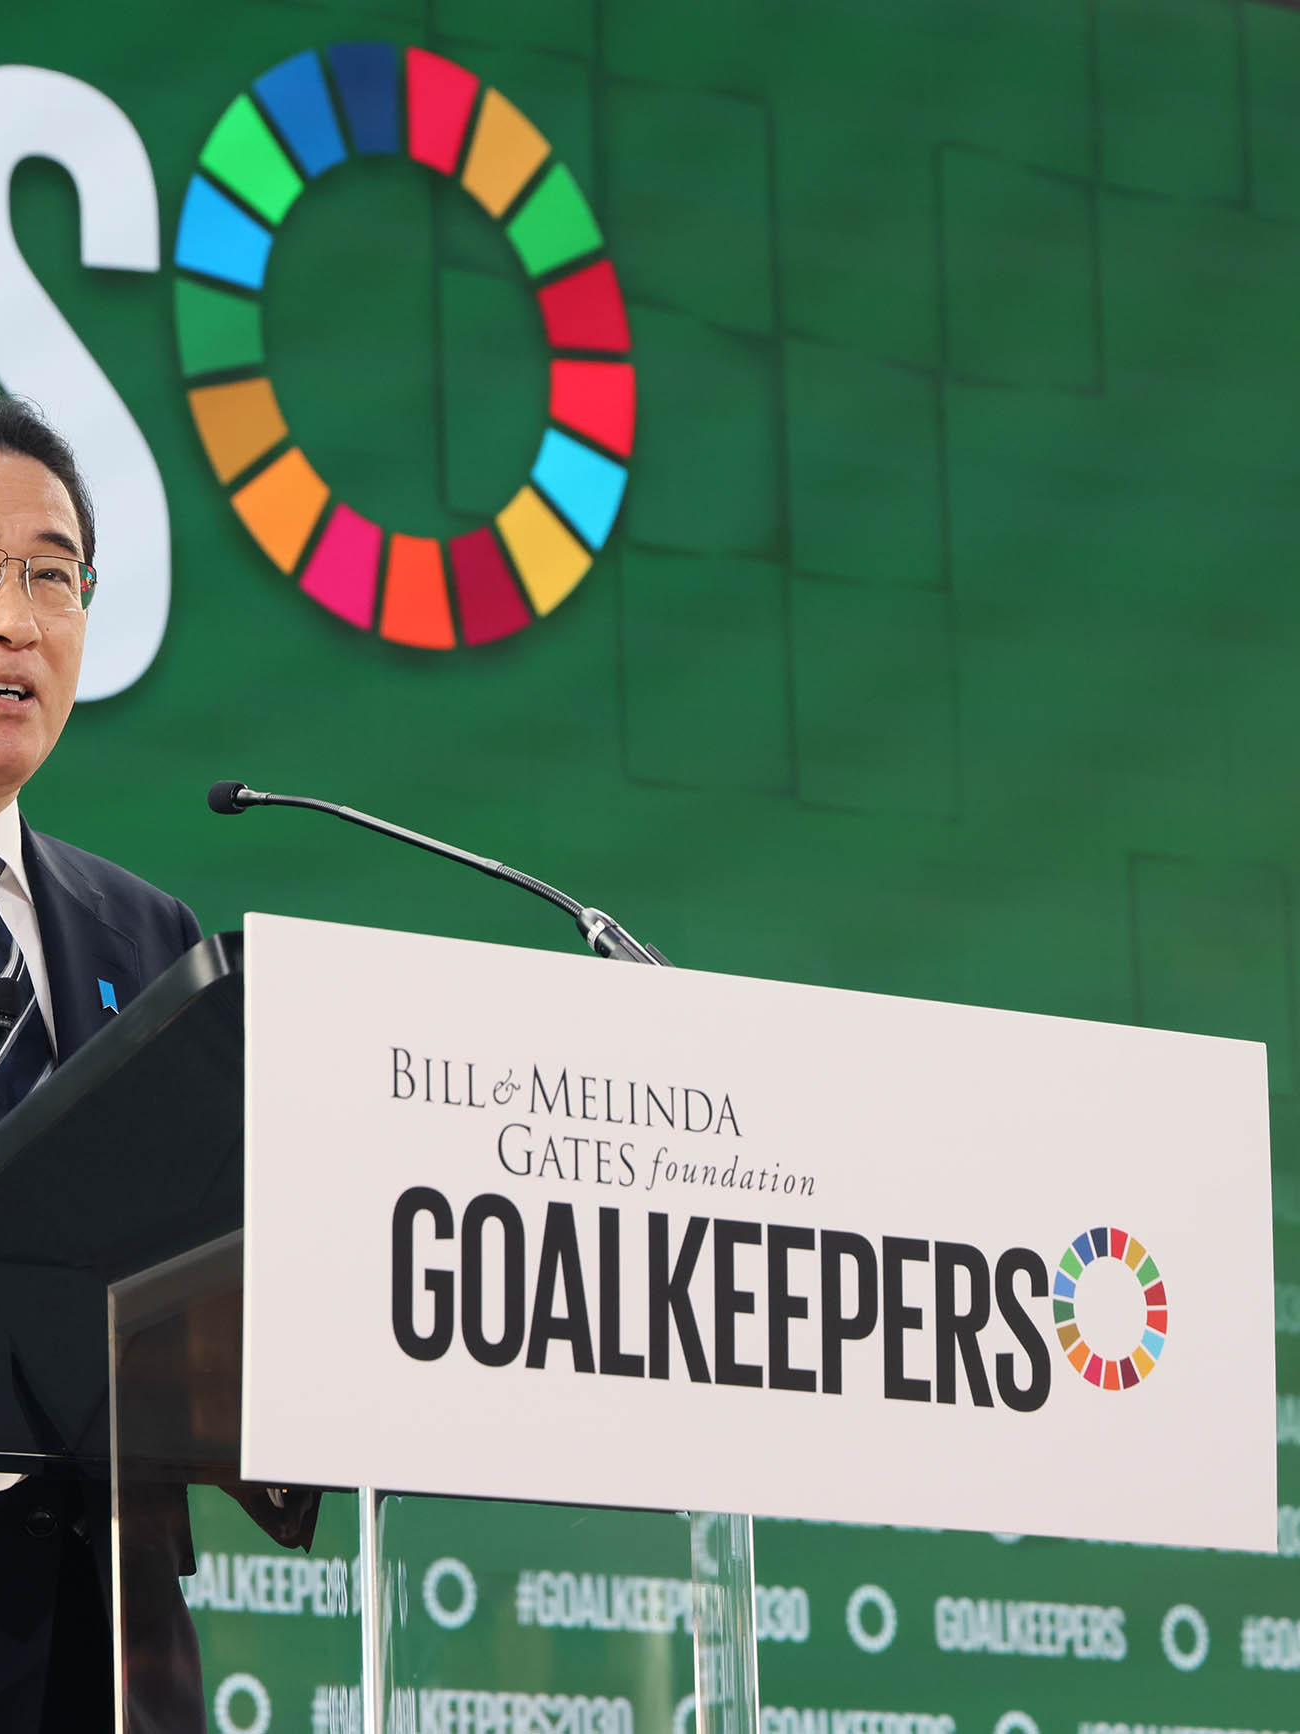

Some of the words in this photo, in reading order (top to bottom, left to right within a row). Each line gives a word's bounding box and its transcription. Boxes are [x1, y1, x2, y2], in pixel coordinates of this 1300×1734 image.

[390, 1046, 485, 1109] BILL
[492, 1068, 522, 1105] &
[529, 1062, 743, 1137] MELINDA
[497, 1122, 636, 1188] GATES
[644, 1146, 816, 1197] foundation
[390, 1185, 1052, 1413] GOALKEEPERS
[935, 1595, 1127, 1662] GOALKEEPERS
